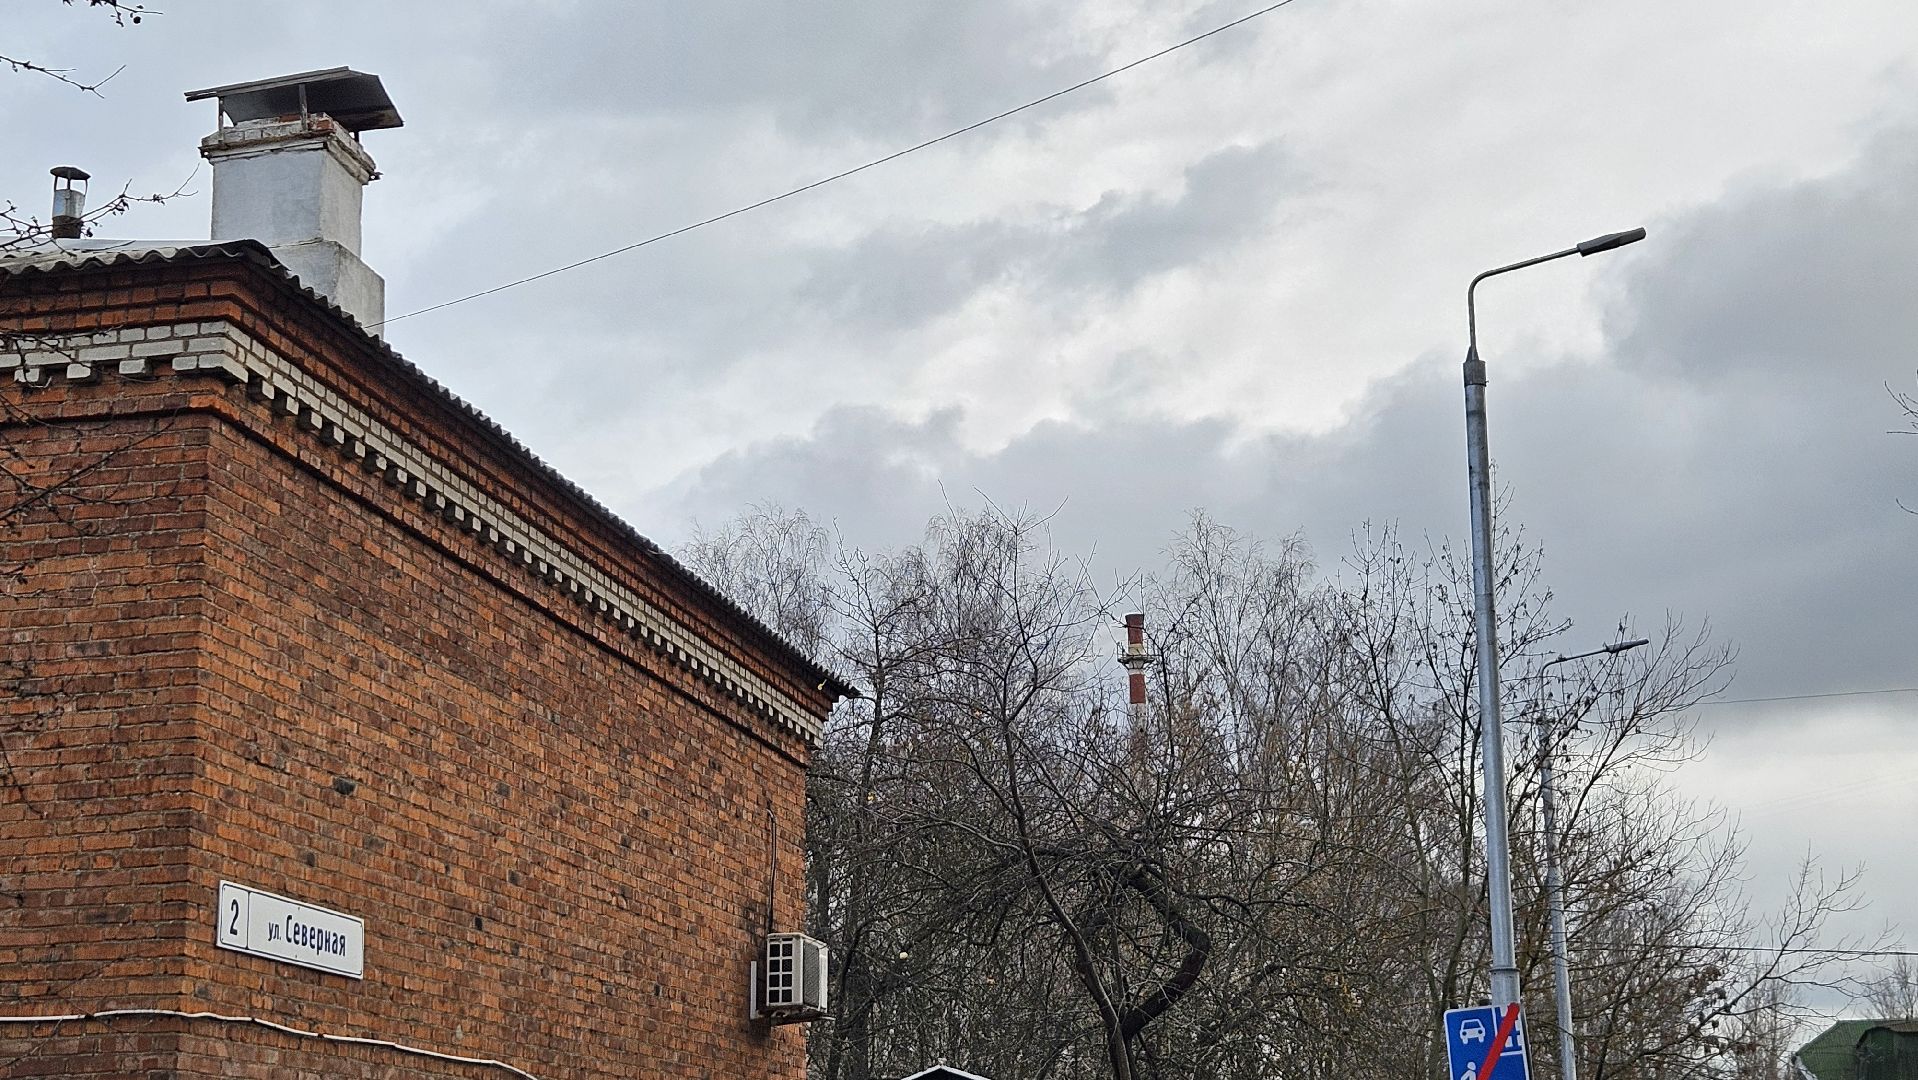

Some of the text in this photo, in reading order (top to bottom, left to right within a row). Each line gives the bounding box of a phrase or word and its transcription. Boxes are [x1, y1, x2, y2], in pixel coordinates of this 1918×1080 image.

[229, 899, 239, 936] 2
[267, 914, 346, 957] ул. Северная
